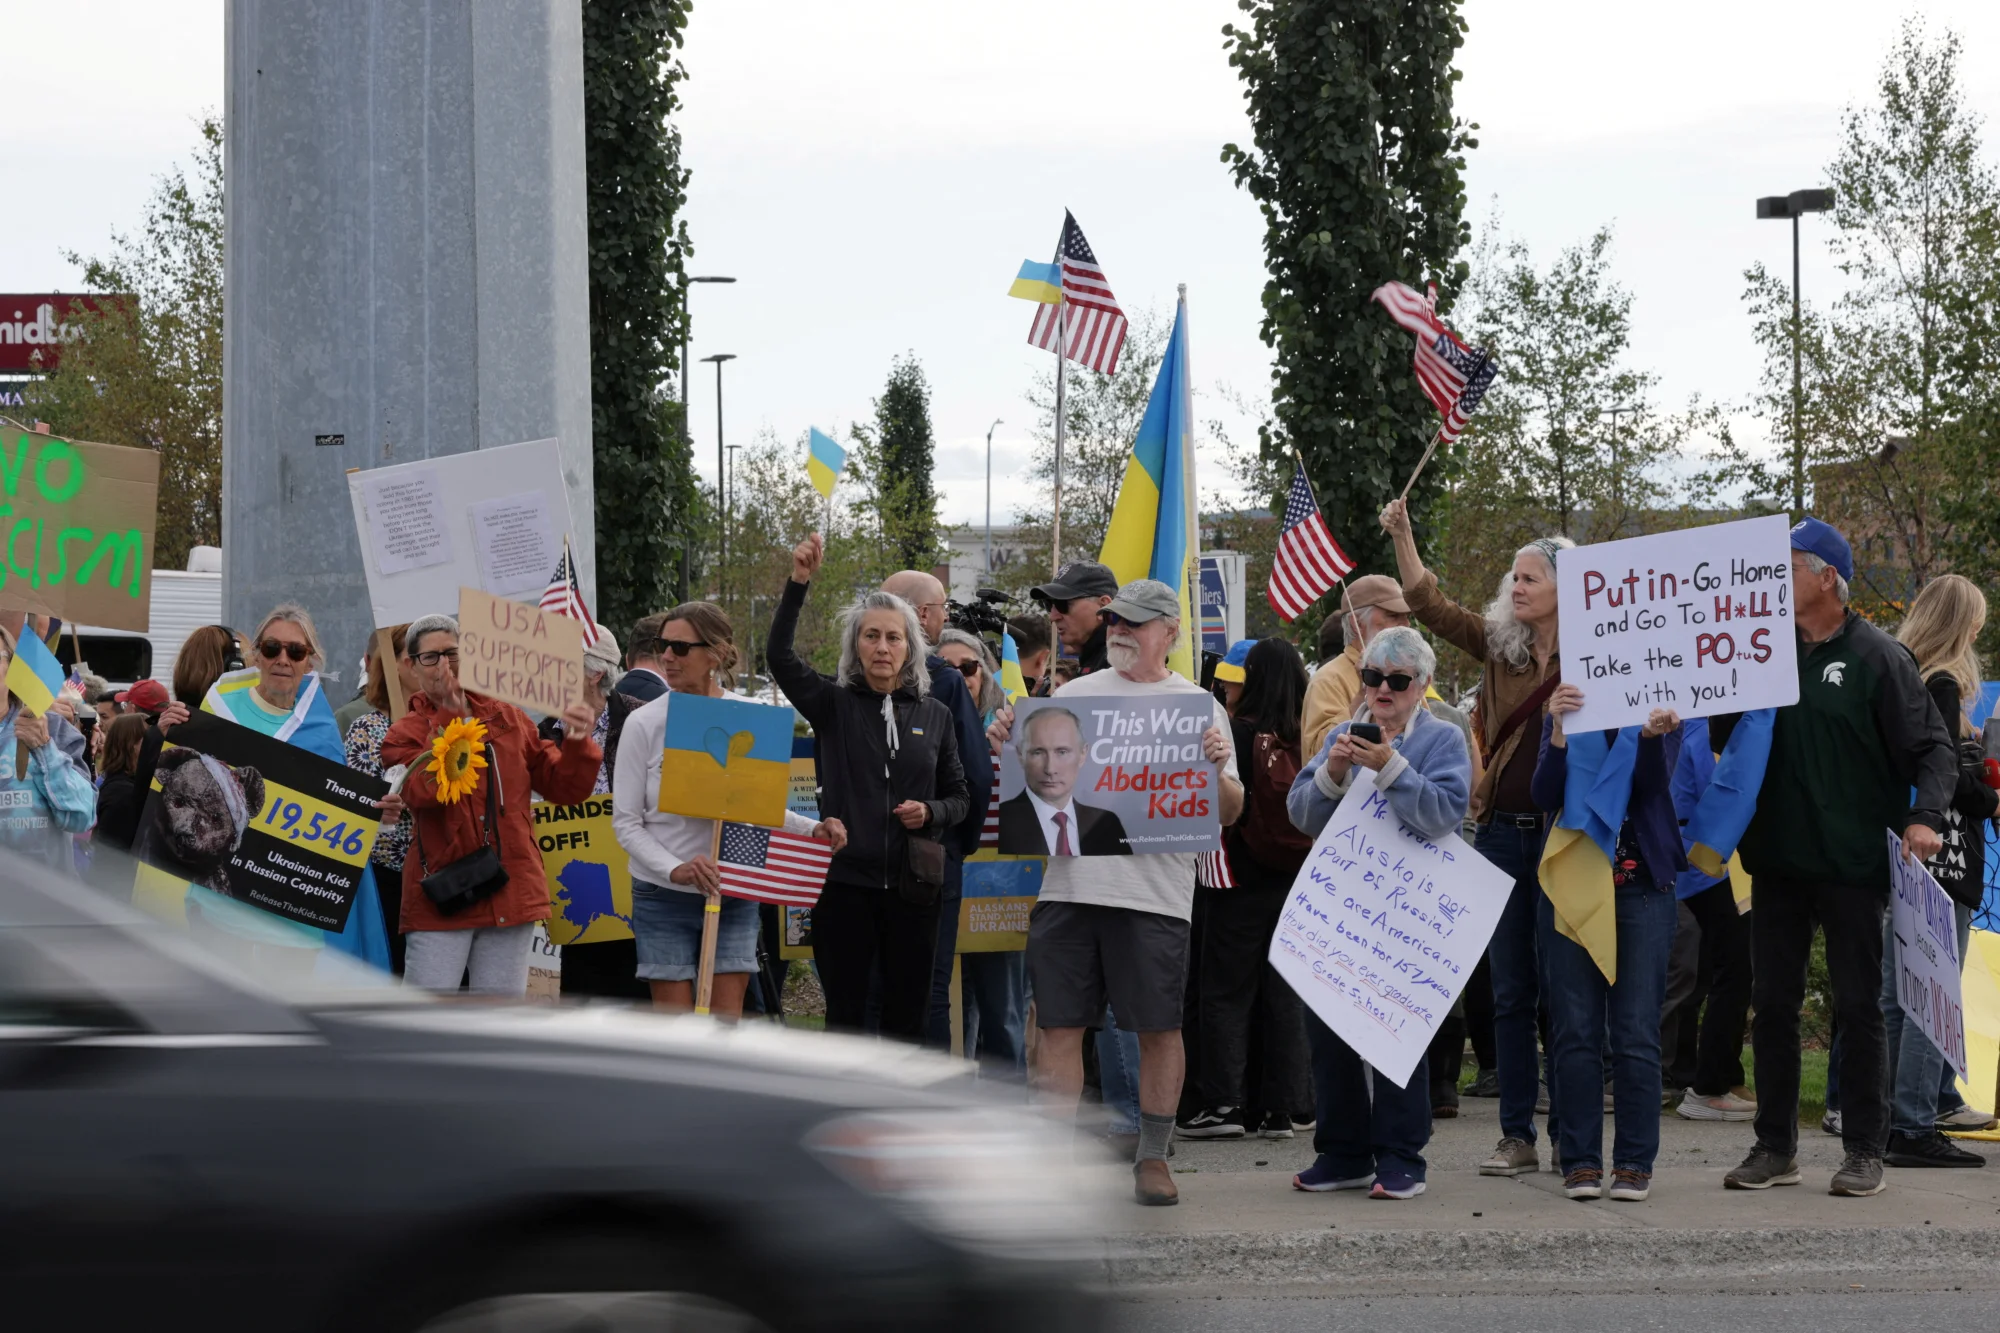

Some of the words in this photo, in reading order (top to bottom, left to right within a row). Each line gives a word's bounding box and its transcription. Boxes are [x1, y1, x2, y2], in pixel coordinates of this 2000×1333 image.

[1731, 558, 1787, 586] Home
[491, 600, 548, 638] USA
[1594, 610, 1629, 638] and
[1636, 609, 1666, 630] Go
[1677, 602, 1705, 624] To
[464, 631, 578, 686] SUPPORTS
[1579, 654, 1632, 679] Take
[1644, 647, 1683, 671] the
[473, 662, 577, 712] UKRAINE
[1625, 681, 1676, 707] with
[1690, 668, 1738, 708] you!
[1091, 709, 1145, 737] This
[1150, 708, 1208, 735] War
[1090, 738, 1206, 765] Criminal
[325, 778, 357, 800] There
[358, 795, 377, 808] are
[1094, 765, 1208, 792] Abducts
[534, 799, 613, 824] HANDS
[1148, 792, 1209, 819] Kids
[264, 797, 365, 855] 19,546
[1119, 834, 1212, 844] www.ReleaseTheKids.com
[538, 831, 590, 852] OFF!
[230, 855, 242, 867] in
[245, 859, 287, 884] Russian
[290, 877, 345, 905] Captivity.
[267, 850, 322, 879] Ukrainian
[325, 872, 351, 888] Kids
[1335, 825, 1414, 883] Alaska
[1417, 873, 1434, 894] is
[1438, 893, 1471, 917] not
[1363, 870, 1385, 891] of
[1928, 865, 1966, 880] DEMY
[249, 889, 338, 925] ReleaseTheKids.com
[969, 903, 1028, 913] ALASKANS
[969, 913, 1000, 921] STAND
[1004, 912, 1028, 920] WITH
[1310, 866, 1336, 896] We
[1343, 897, 1371, 919] are
[1370, 911, 1461, 974] Americans
[969, 921, 1029, 932] UKRAINE
[1283, 908, 1306, 931] How
[1306, 930, 1331, 948] did
[1336, 920, 1368, 949] been
